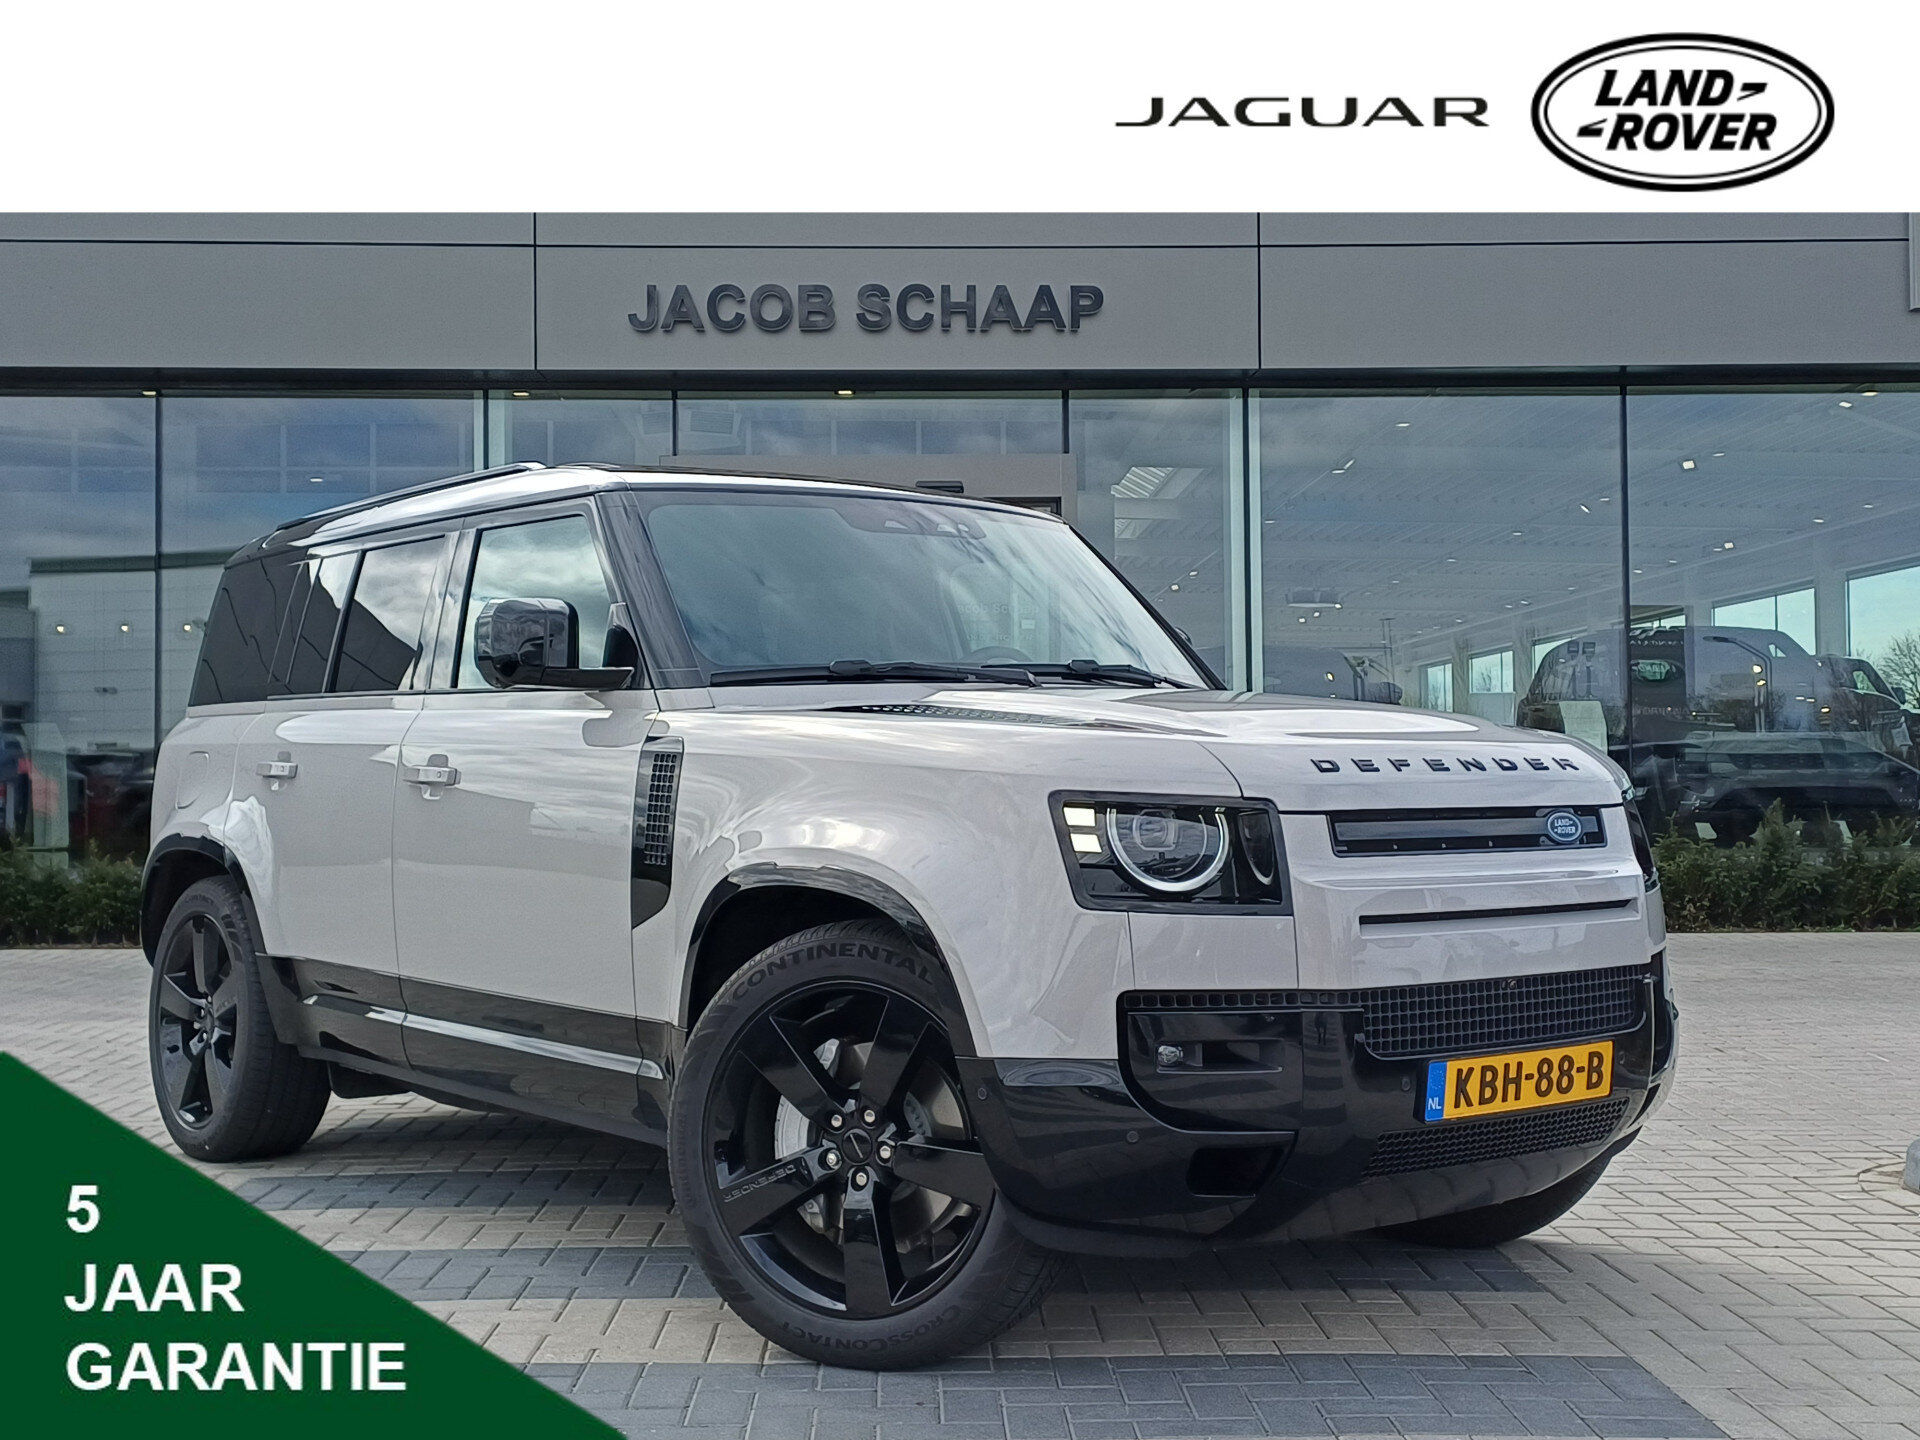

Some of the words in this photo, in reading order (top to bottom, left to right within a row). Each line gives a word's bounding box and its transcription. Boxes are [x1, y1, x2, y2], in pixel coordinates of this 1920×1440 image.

[627, 283, 837, 333] JACOB
[855, 283, 1105, 333] SCHAAP
[1310, 757, 1580, 772] DEFENDER
[1554, 818, 1570, 826] LAND
[733, 942, 934, 1000] CONTINENTAL
[1427, 1098, 1441, 1110] NL
[1453, 1050, 1604, 1109] KBH-88-B
